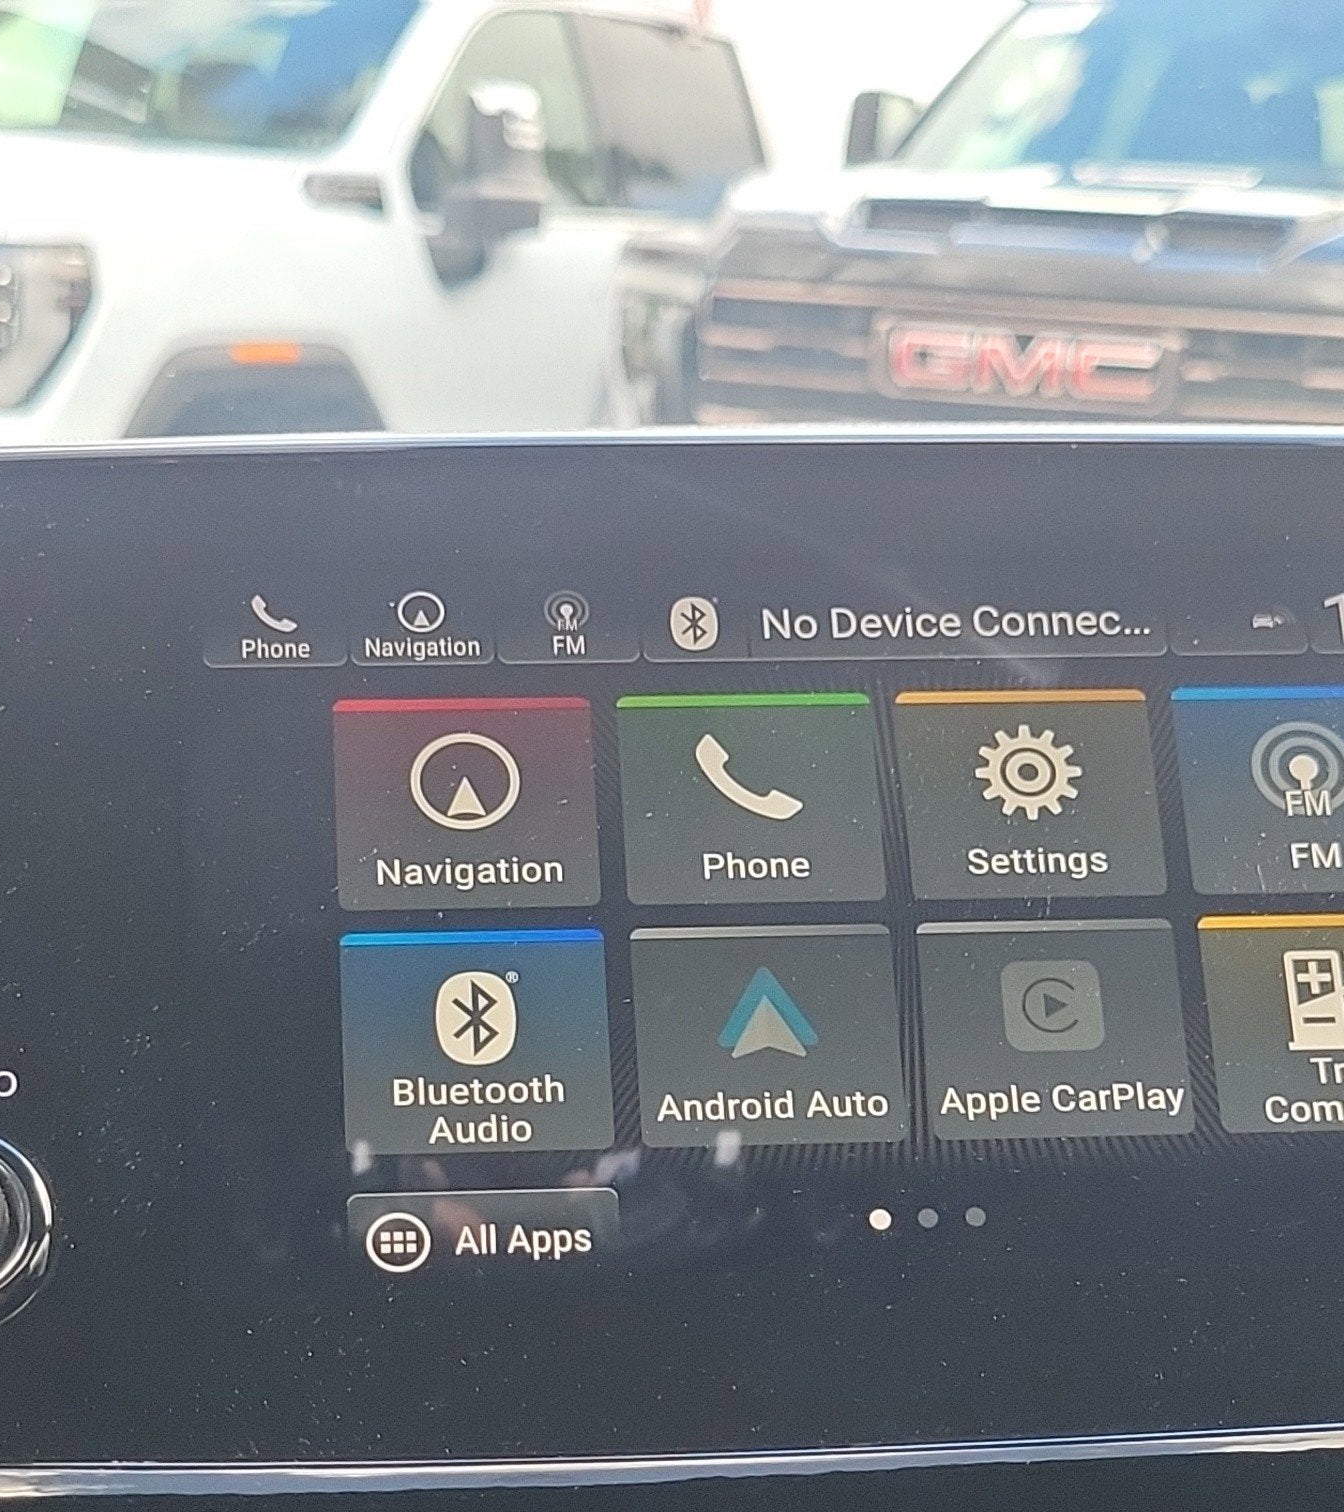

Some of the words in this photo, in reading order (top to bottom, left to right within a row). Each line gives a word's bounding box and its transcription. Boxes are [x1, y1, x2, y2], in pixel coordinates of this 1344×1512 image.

[890, 323, 1164, 399] GMC
[761, 608, 818, 640] No
[830, 607, 962, 639] Device
[972, 605, 1151, 638] Connec...
[241, 638, 311, 659] Phone
[364, 636, 481, 661] Navigation
[552, 635, 586, 656] FM
[1284, 790, 1333, 817] FM
[702, 852, 810, 880] Phone
[967, 847, 1109, 879] Settings
[1290, 842, 1343, 869] FM
[375, 858, 564, 891] Navigation
[392, 1074, 565, 1107] Bluetooth
[940, 1084, 1041, 1121] Apple
[1052, 1082, 1185, 1117] CarPlay
[657, 1090, 795, 1124] Android
[806, 1090, 889, 1118] Auto
[428, 1115, 532, 1145] Audio
[455, 1224, 497, 1255] All
[507, 1224, 592, 1260] Apps
